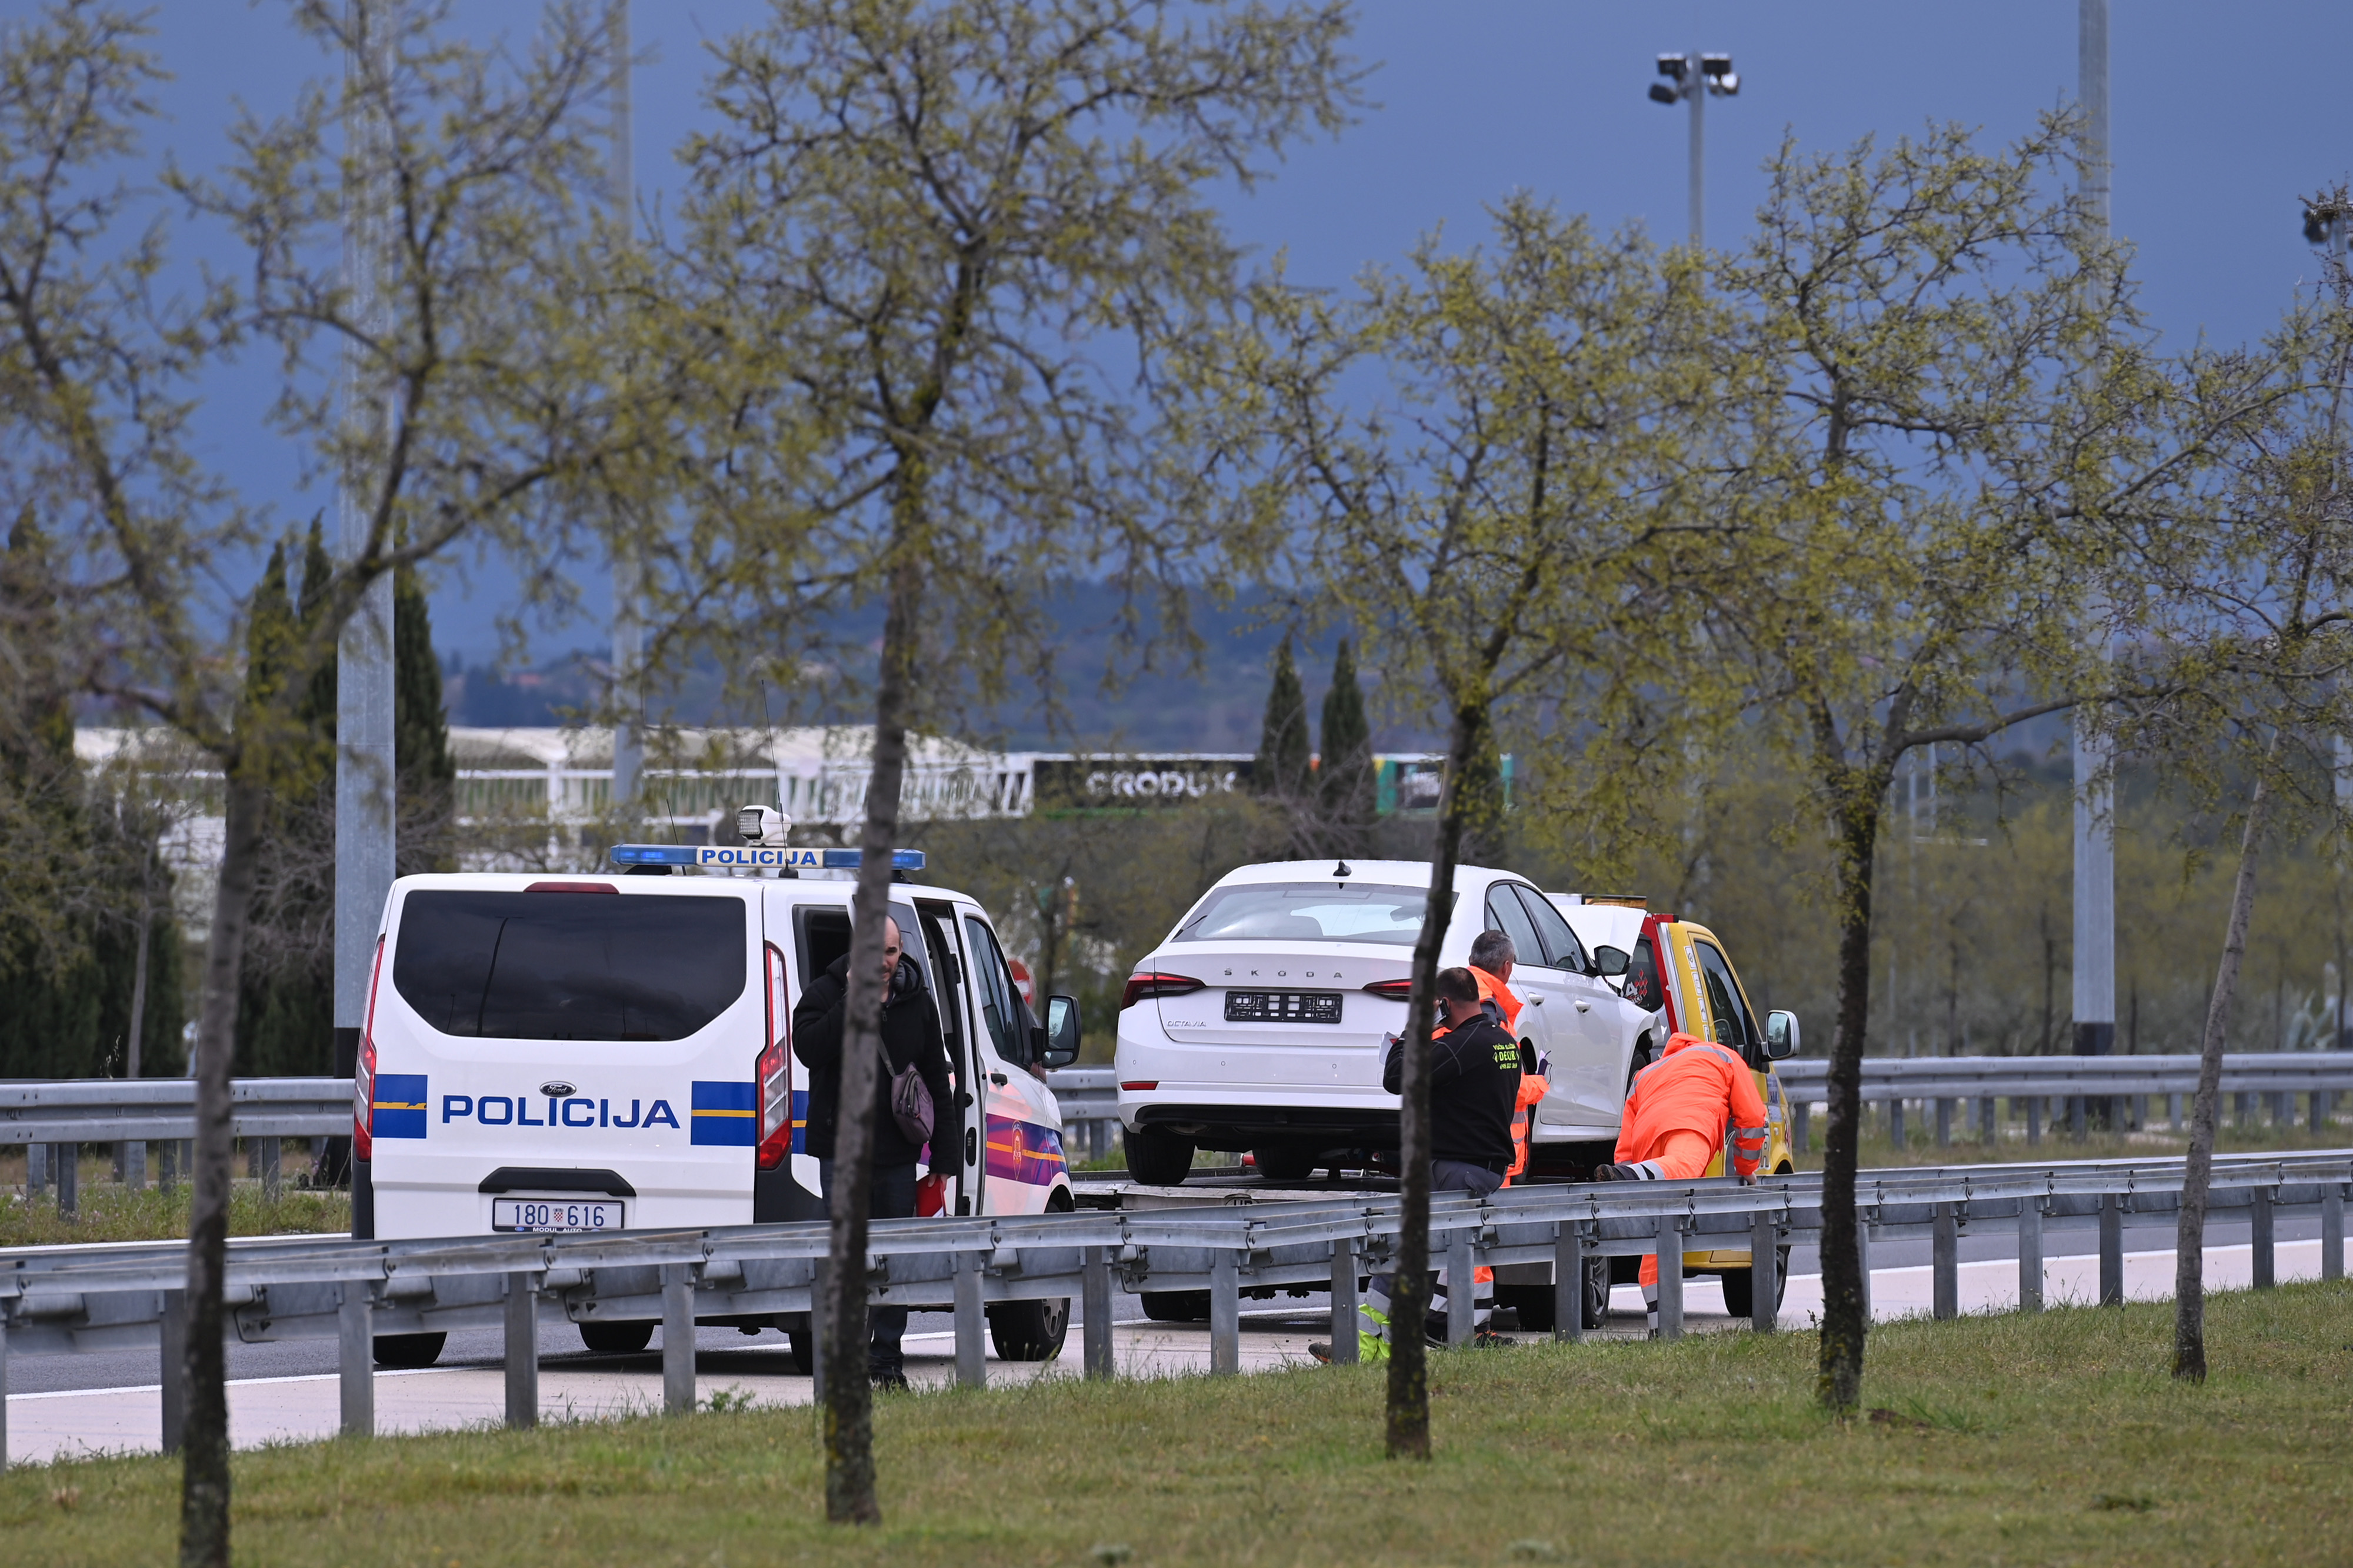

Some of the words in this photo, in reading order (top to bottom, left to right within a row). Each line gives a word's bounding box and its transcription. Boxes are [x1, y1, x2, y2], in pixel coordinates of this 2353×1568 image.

[1086, 771, 1235, 798] CRODUX
[702, 850, 818, 865] POLICIJA
[1166, 1019, 1207, 1027] OCTAVIA
[547, 1084, 568, 1093] Ford
[442, 1095, 681, 1129] POLICIJA
[515, 1205, 548, 1225] 180
[568, 1205, 604, 1227] 616
